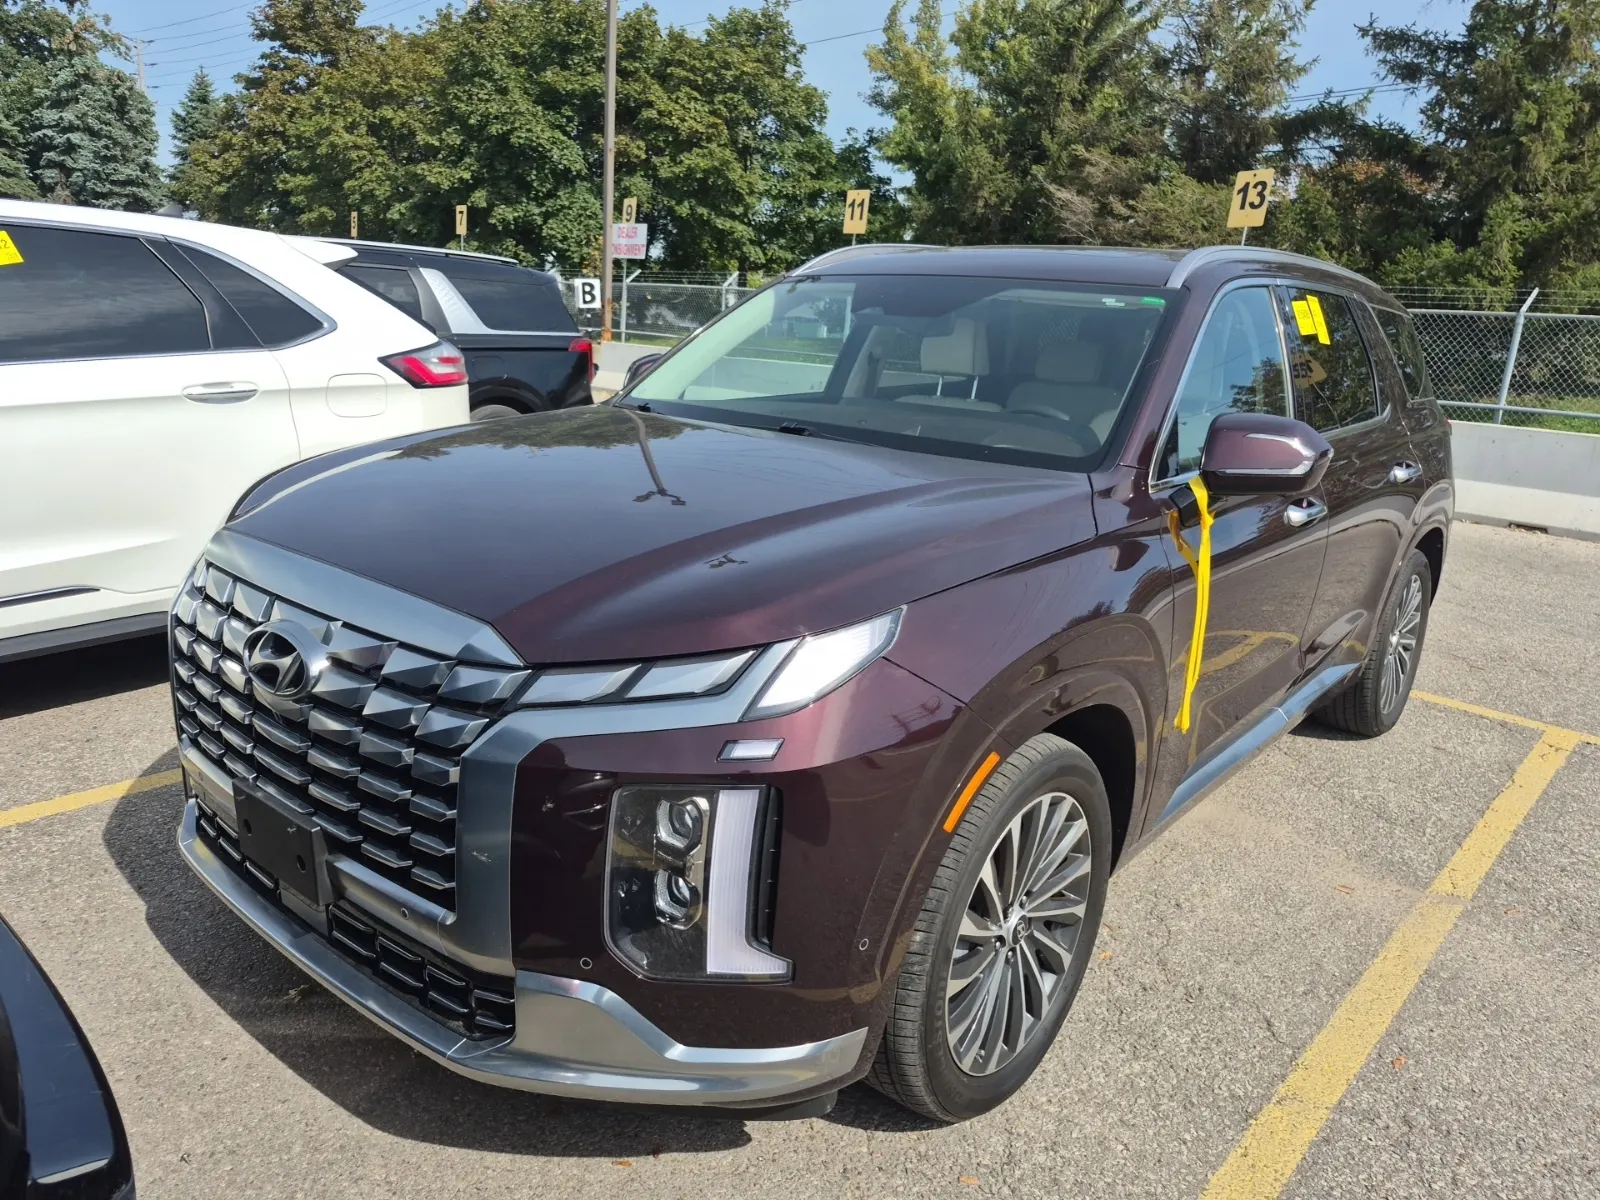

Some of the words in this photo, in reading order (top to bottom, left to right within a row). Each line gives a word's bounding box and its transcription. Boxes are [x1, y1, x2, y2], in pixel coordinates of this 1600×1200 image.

[1236, 180, 1268, 211] 13
[458, 210, 464, 226] 7
[625, 204, 633, 223] 9
[847, 198, 865, 221] 11
[581, 282, 596, 305] B
